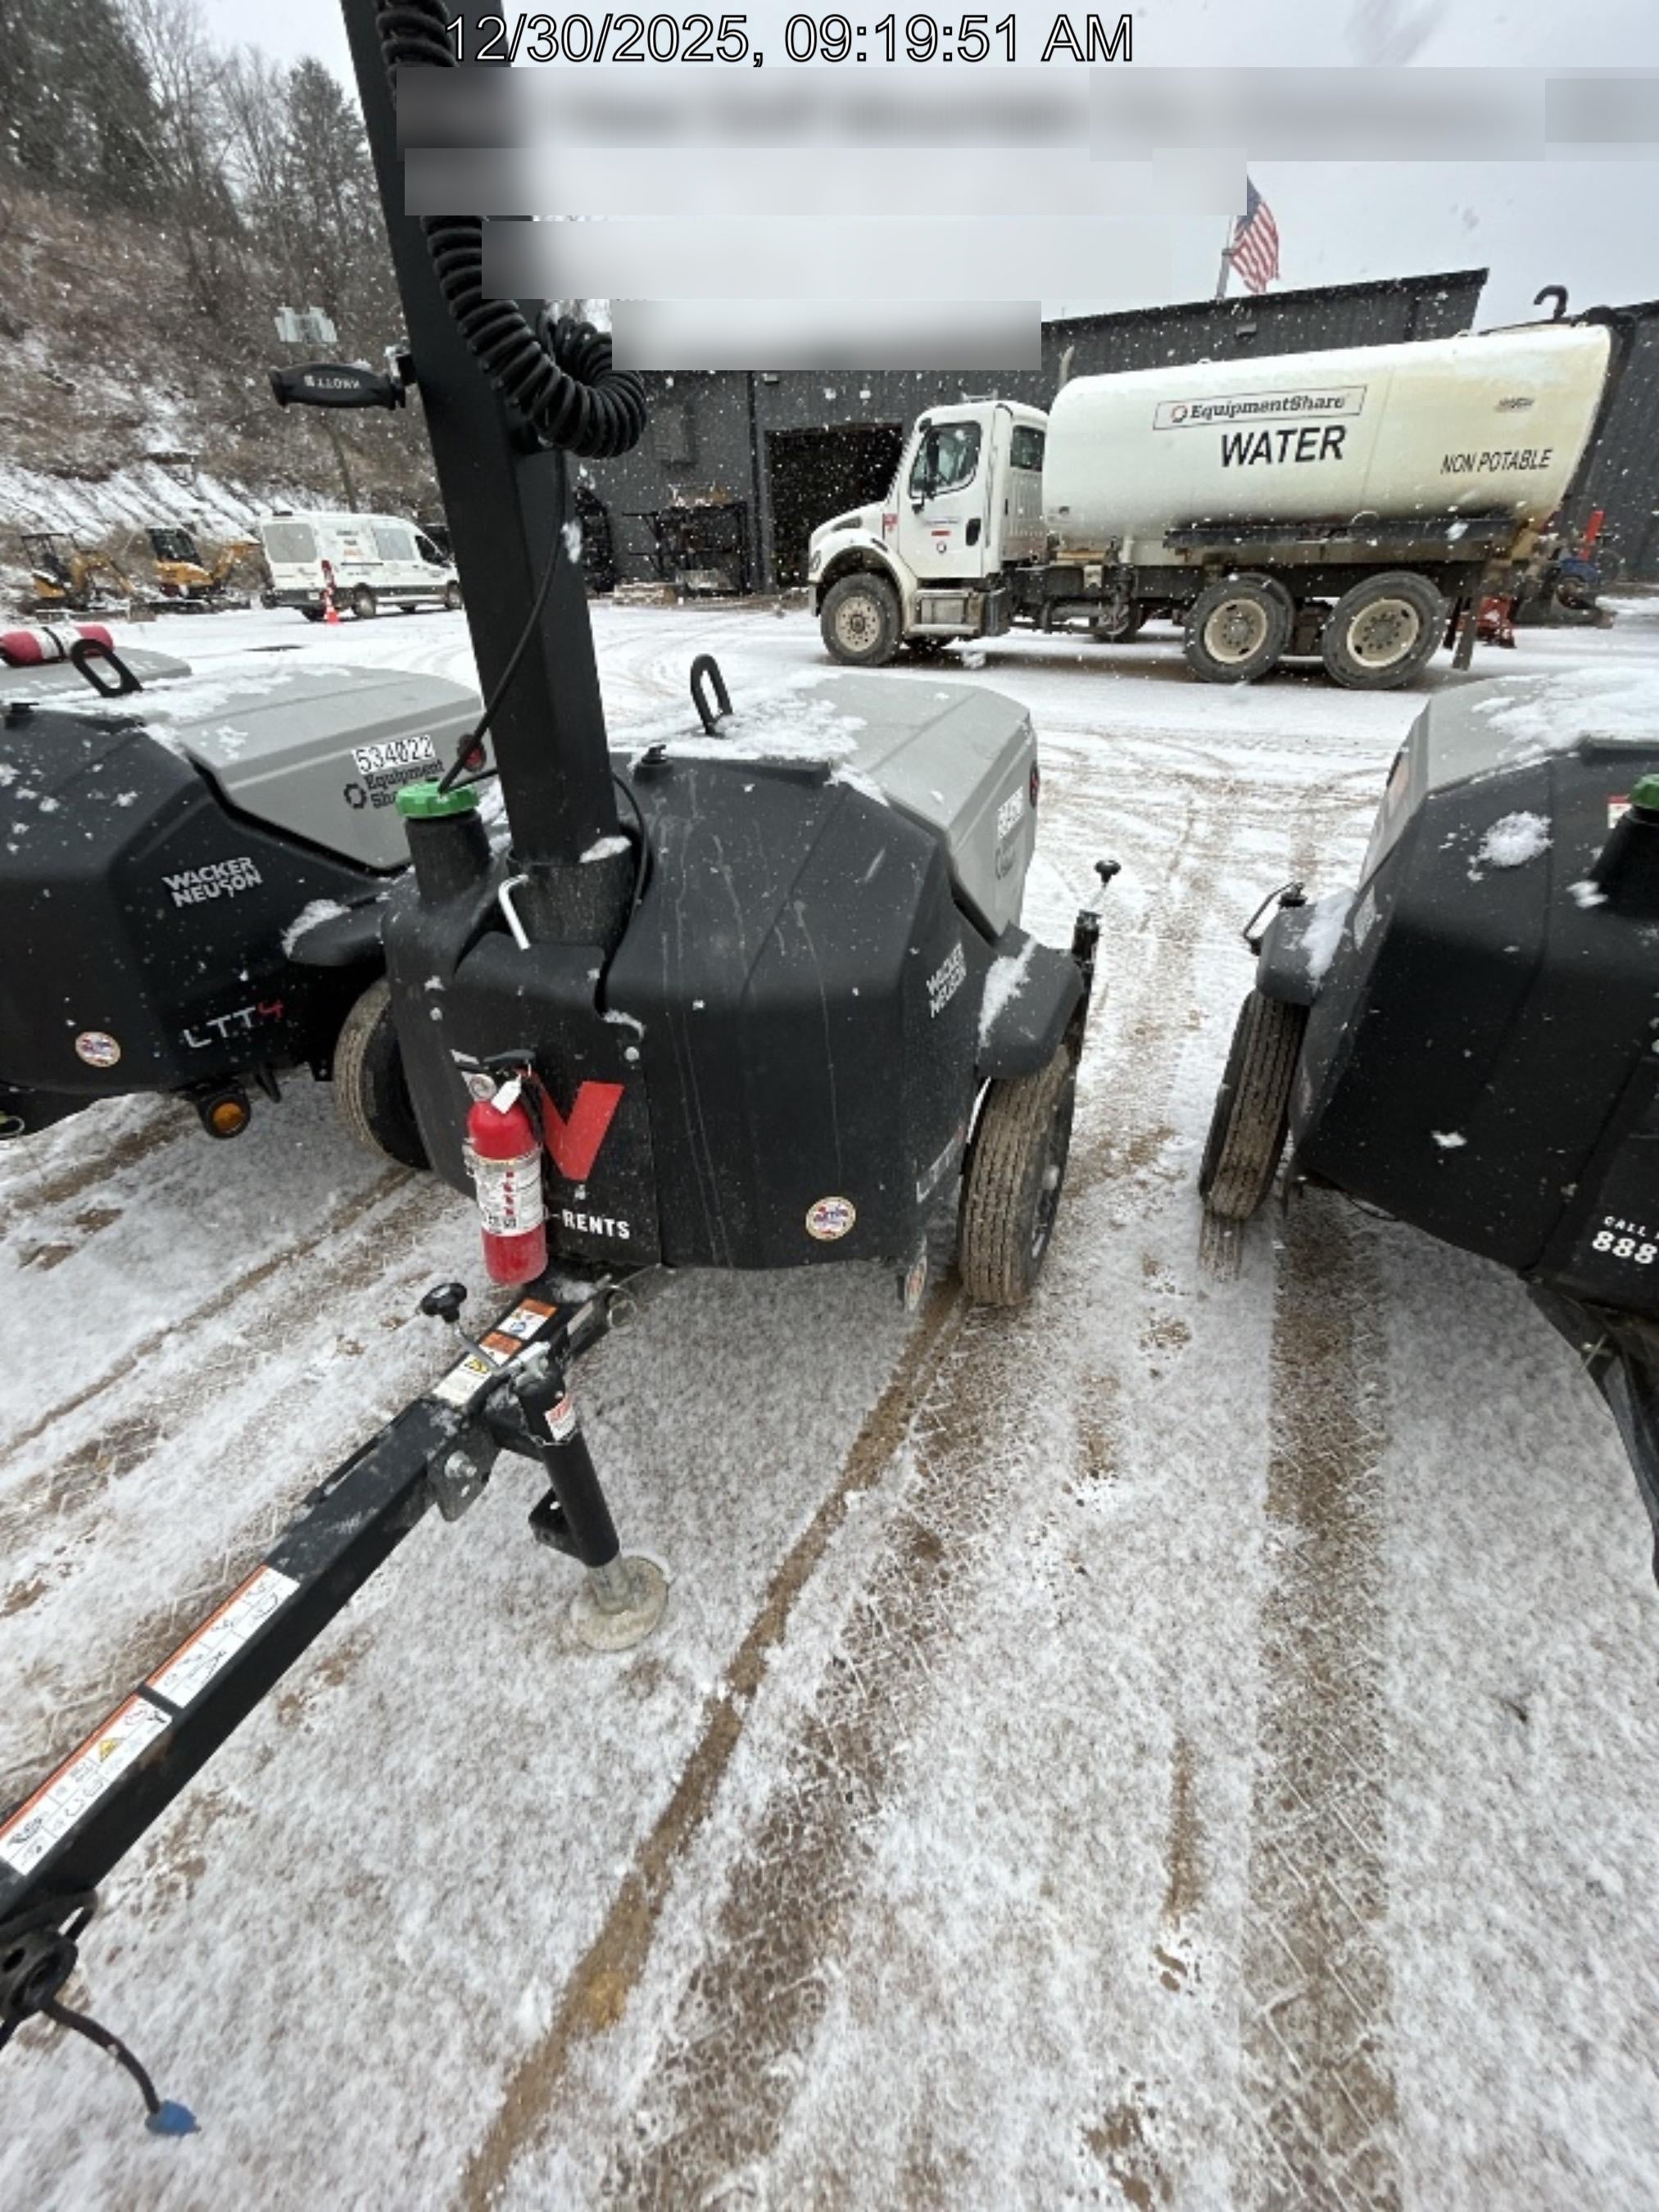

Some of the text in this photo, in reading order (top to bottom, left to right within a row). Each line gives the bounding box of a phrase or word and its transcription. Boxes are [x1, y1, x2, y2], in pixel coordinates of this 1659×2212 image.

[1190, 395, 1346, 420] EquipmentShare
[1221, 424, 1346, 467] WATER
[1439, 448, 1553, 474] NON POTABLE
[355, 736, 435, 773] 534022
[363, 759, 446, 790] Equipment
[161, 857, 254, 891] WACKER
[171, 868, 264, 908] NEUSON
[183, 999, 283, 1049] LTT4
[1592, 1231, 1658, 1264] 888
